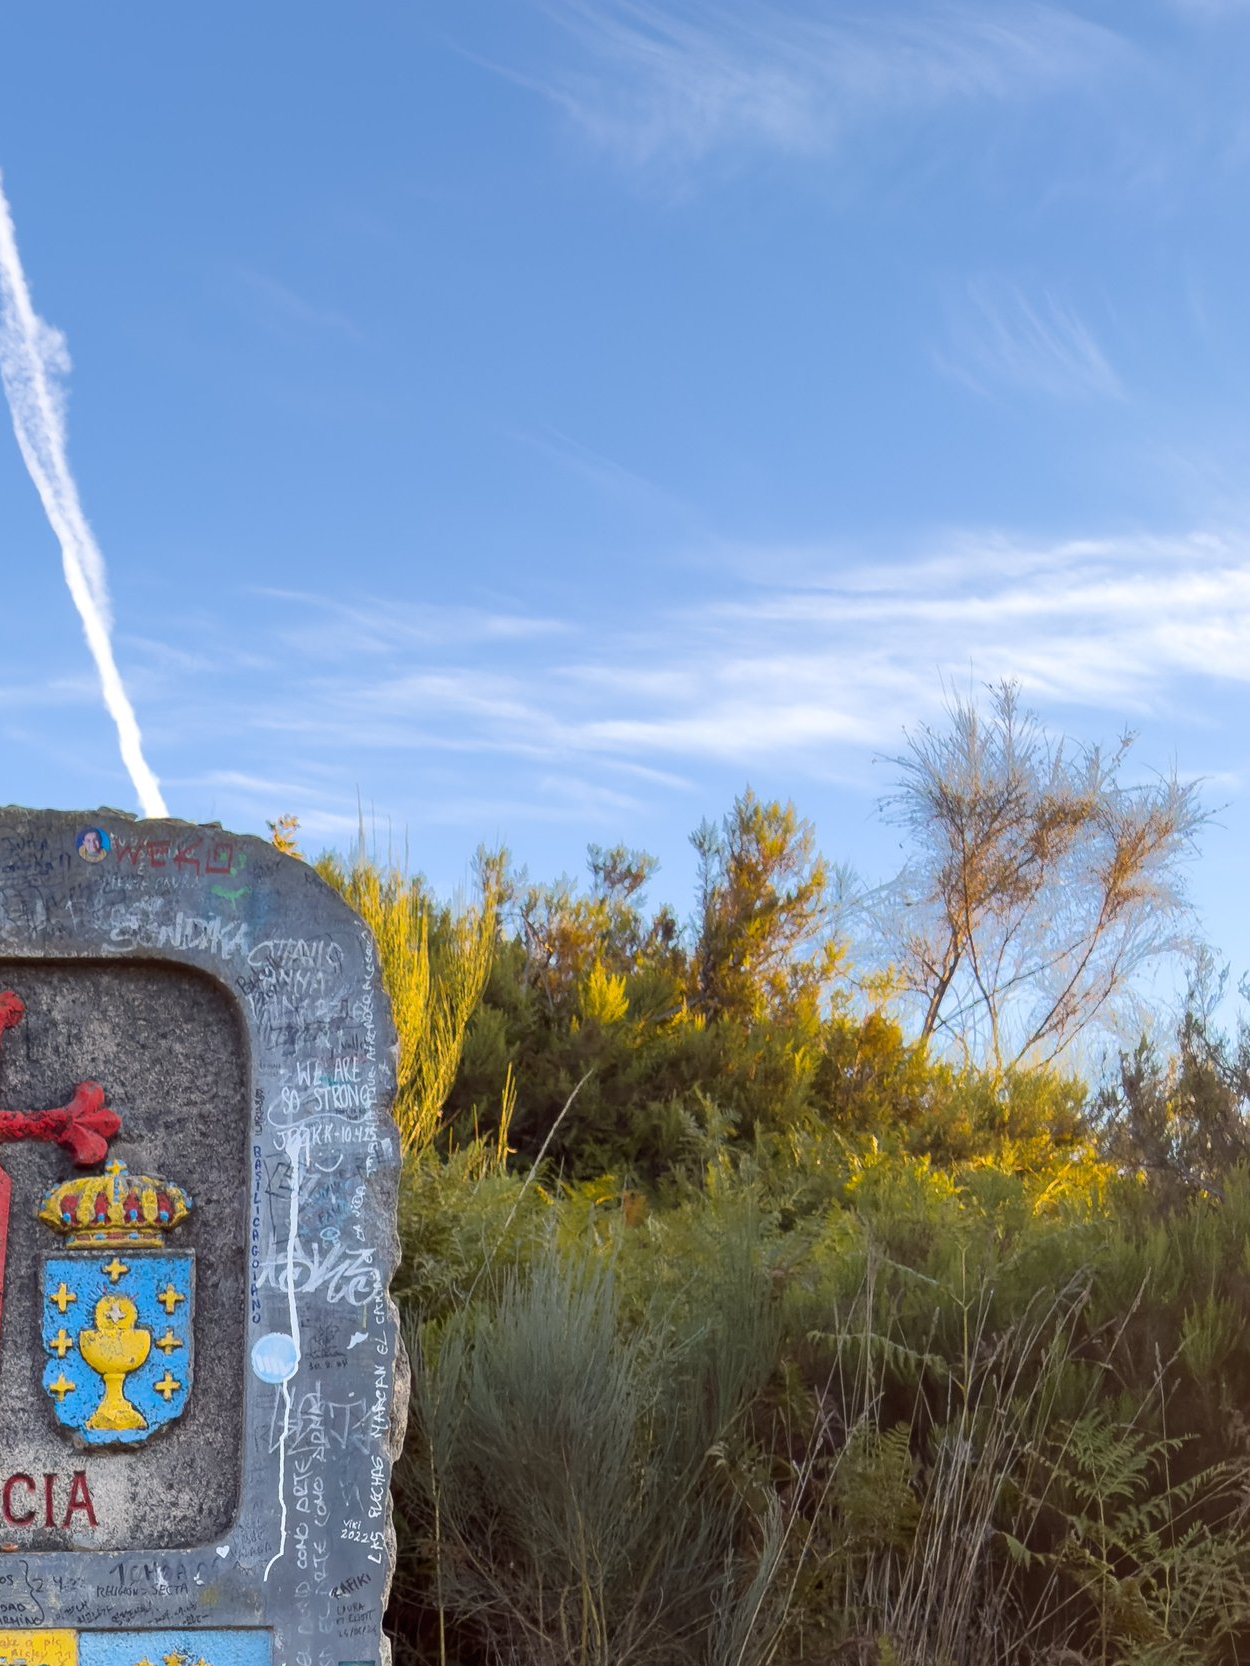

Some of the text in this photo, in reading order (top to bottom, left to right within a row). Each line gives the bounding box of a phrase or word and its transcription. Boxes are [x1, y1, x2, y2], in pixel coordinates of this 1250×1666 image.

[296, 1056, 362, 1087] WE ARE
[280, 1086, 301, 1115] SO
[313, 1084, 370, 1112] STRONG
[376, 1329, 389, 1357] EL
[312, 1476, 331, 1527] COMO
[293, 1522, 310, 1570] COMO
